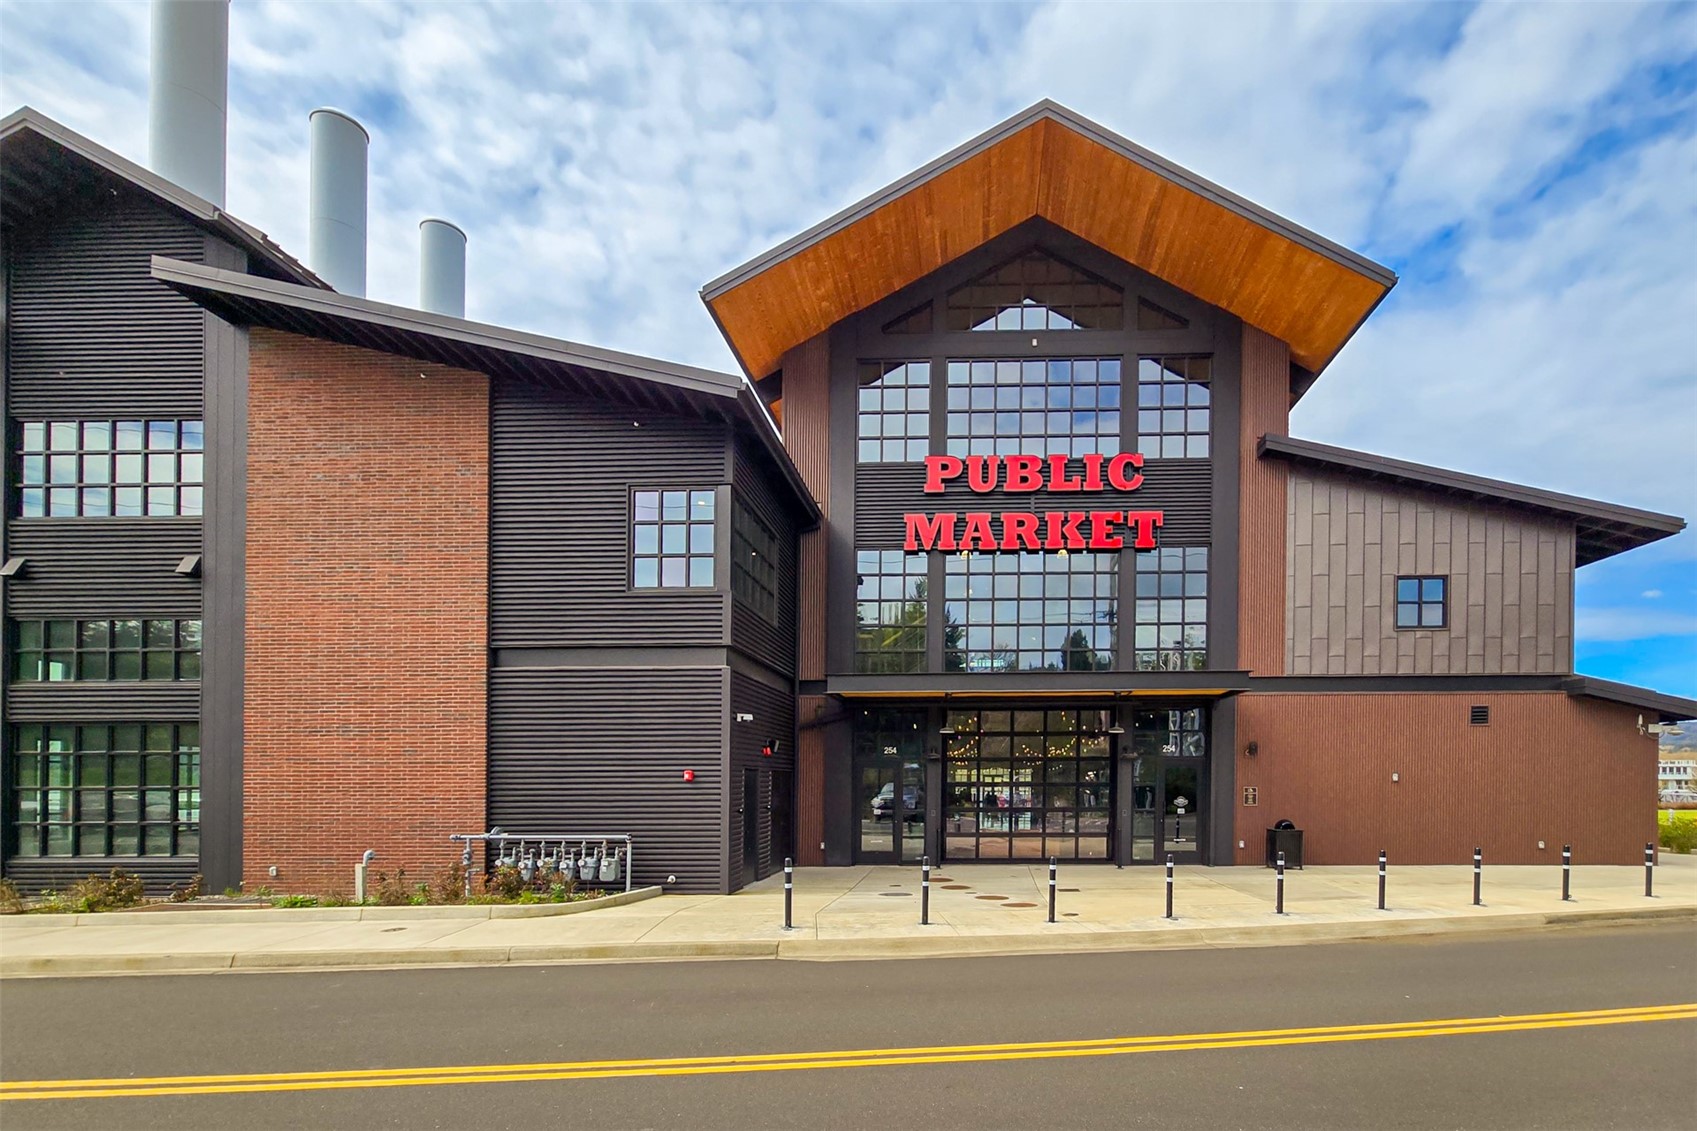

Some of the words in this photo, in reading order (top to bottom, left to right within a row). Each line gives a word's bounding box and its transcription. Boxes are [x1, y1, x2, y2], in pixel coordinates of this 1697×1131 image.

[924, 453, 1144, 493] PUBLIC
[904, 511, 1163, 551] MARKET
[884, 746, 897, 755] 254
[1163, 744, 1176, 753] 254
